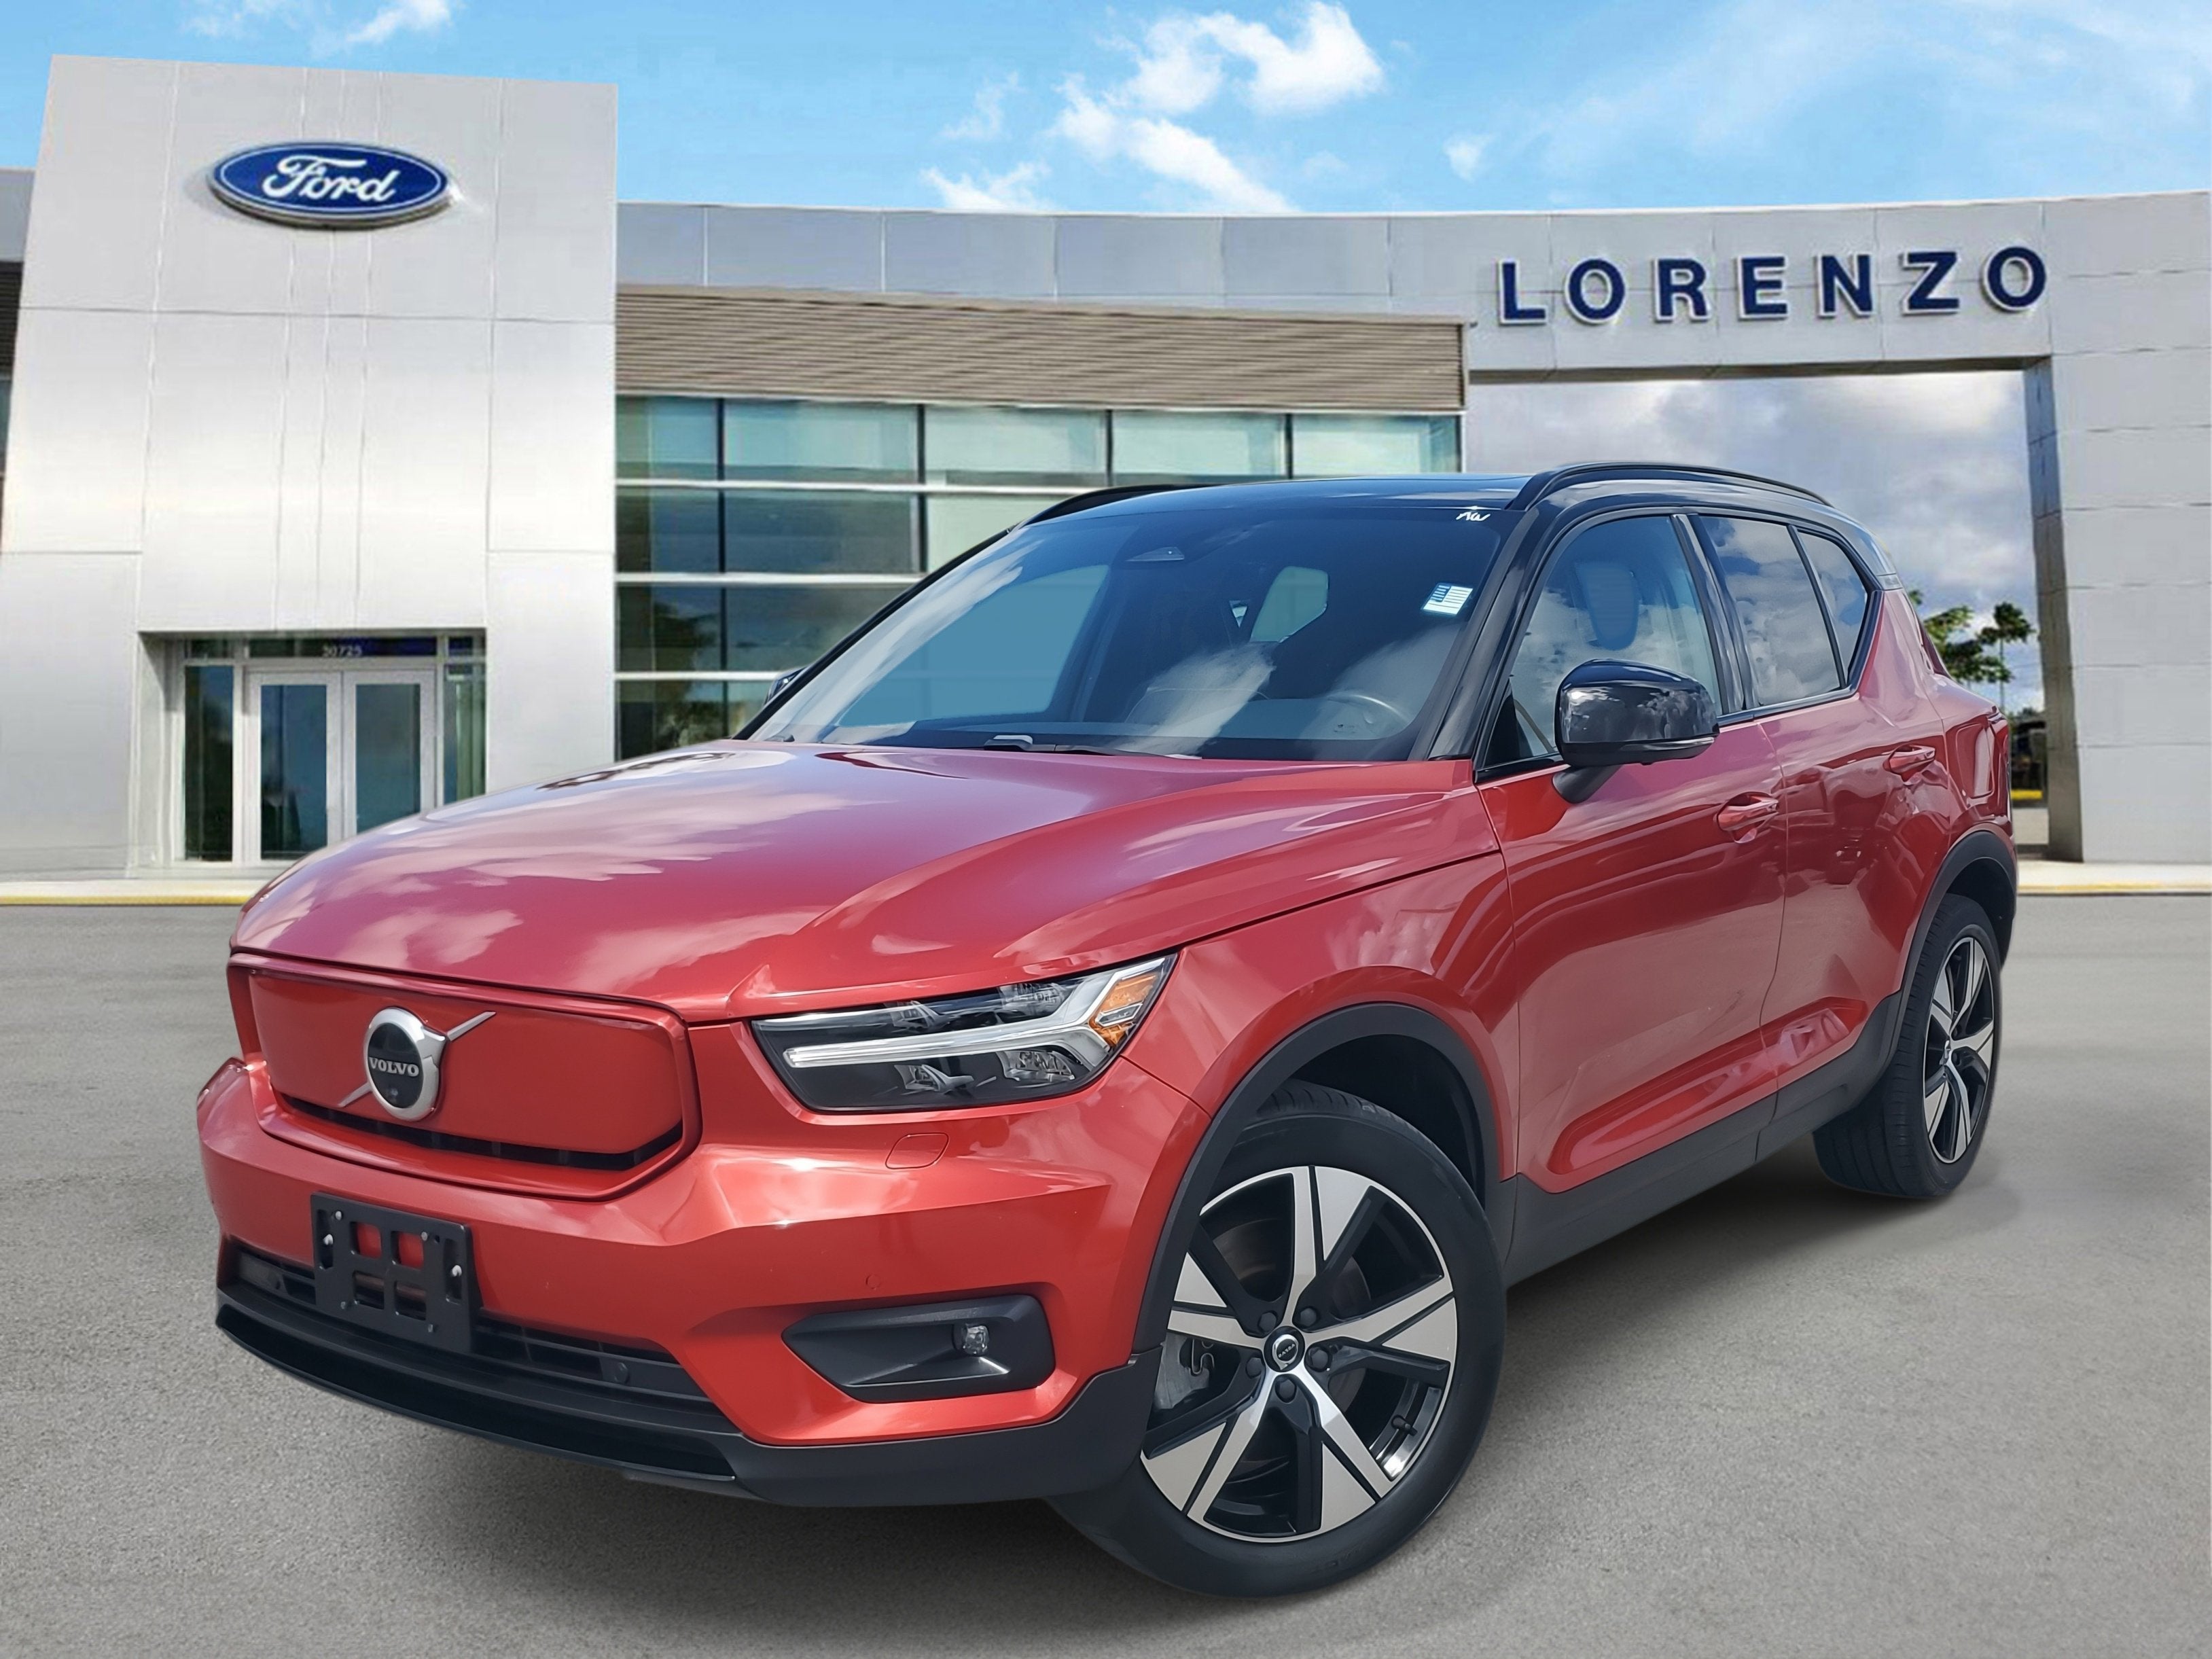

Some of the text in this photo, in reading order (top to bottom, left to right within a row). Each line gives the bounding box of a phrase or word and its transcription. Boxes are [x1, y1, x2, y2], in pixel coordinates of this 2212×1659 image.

[261, 154, 402, 202] Ford
[1497, 245, 2048, 325] LORENZO
[368, 1056, 419, 1077] VOLVO
